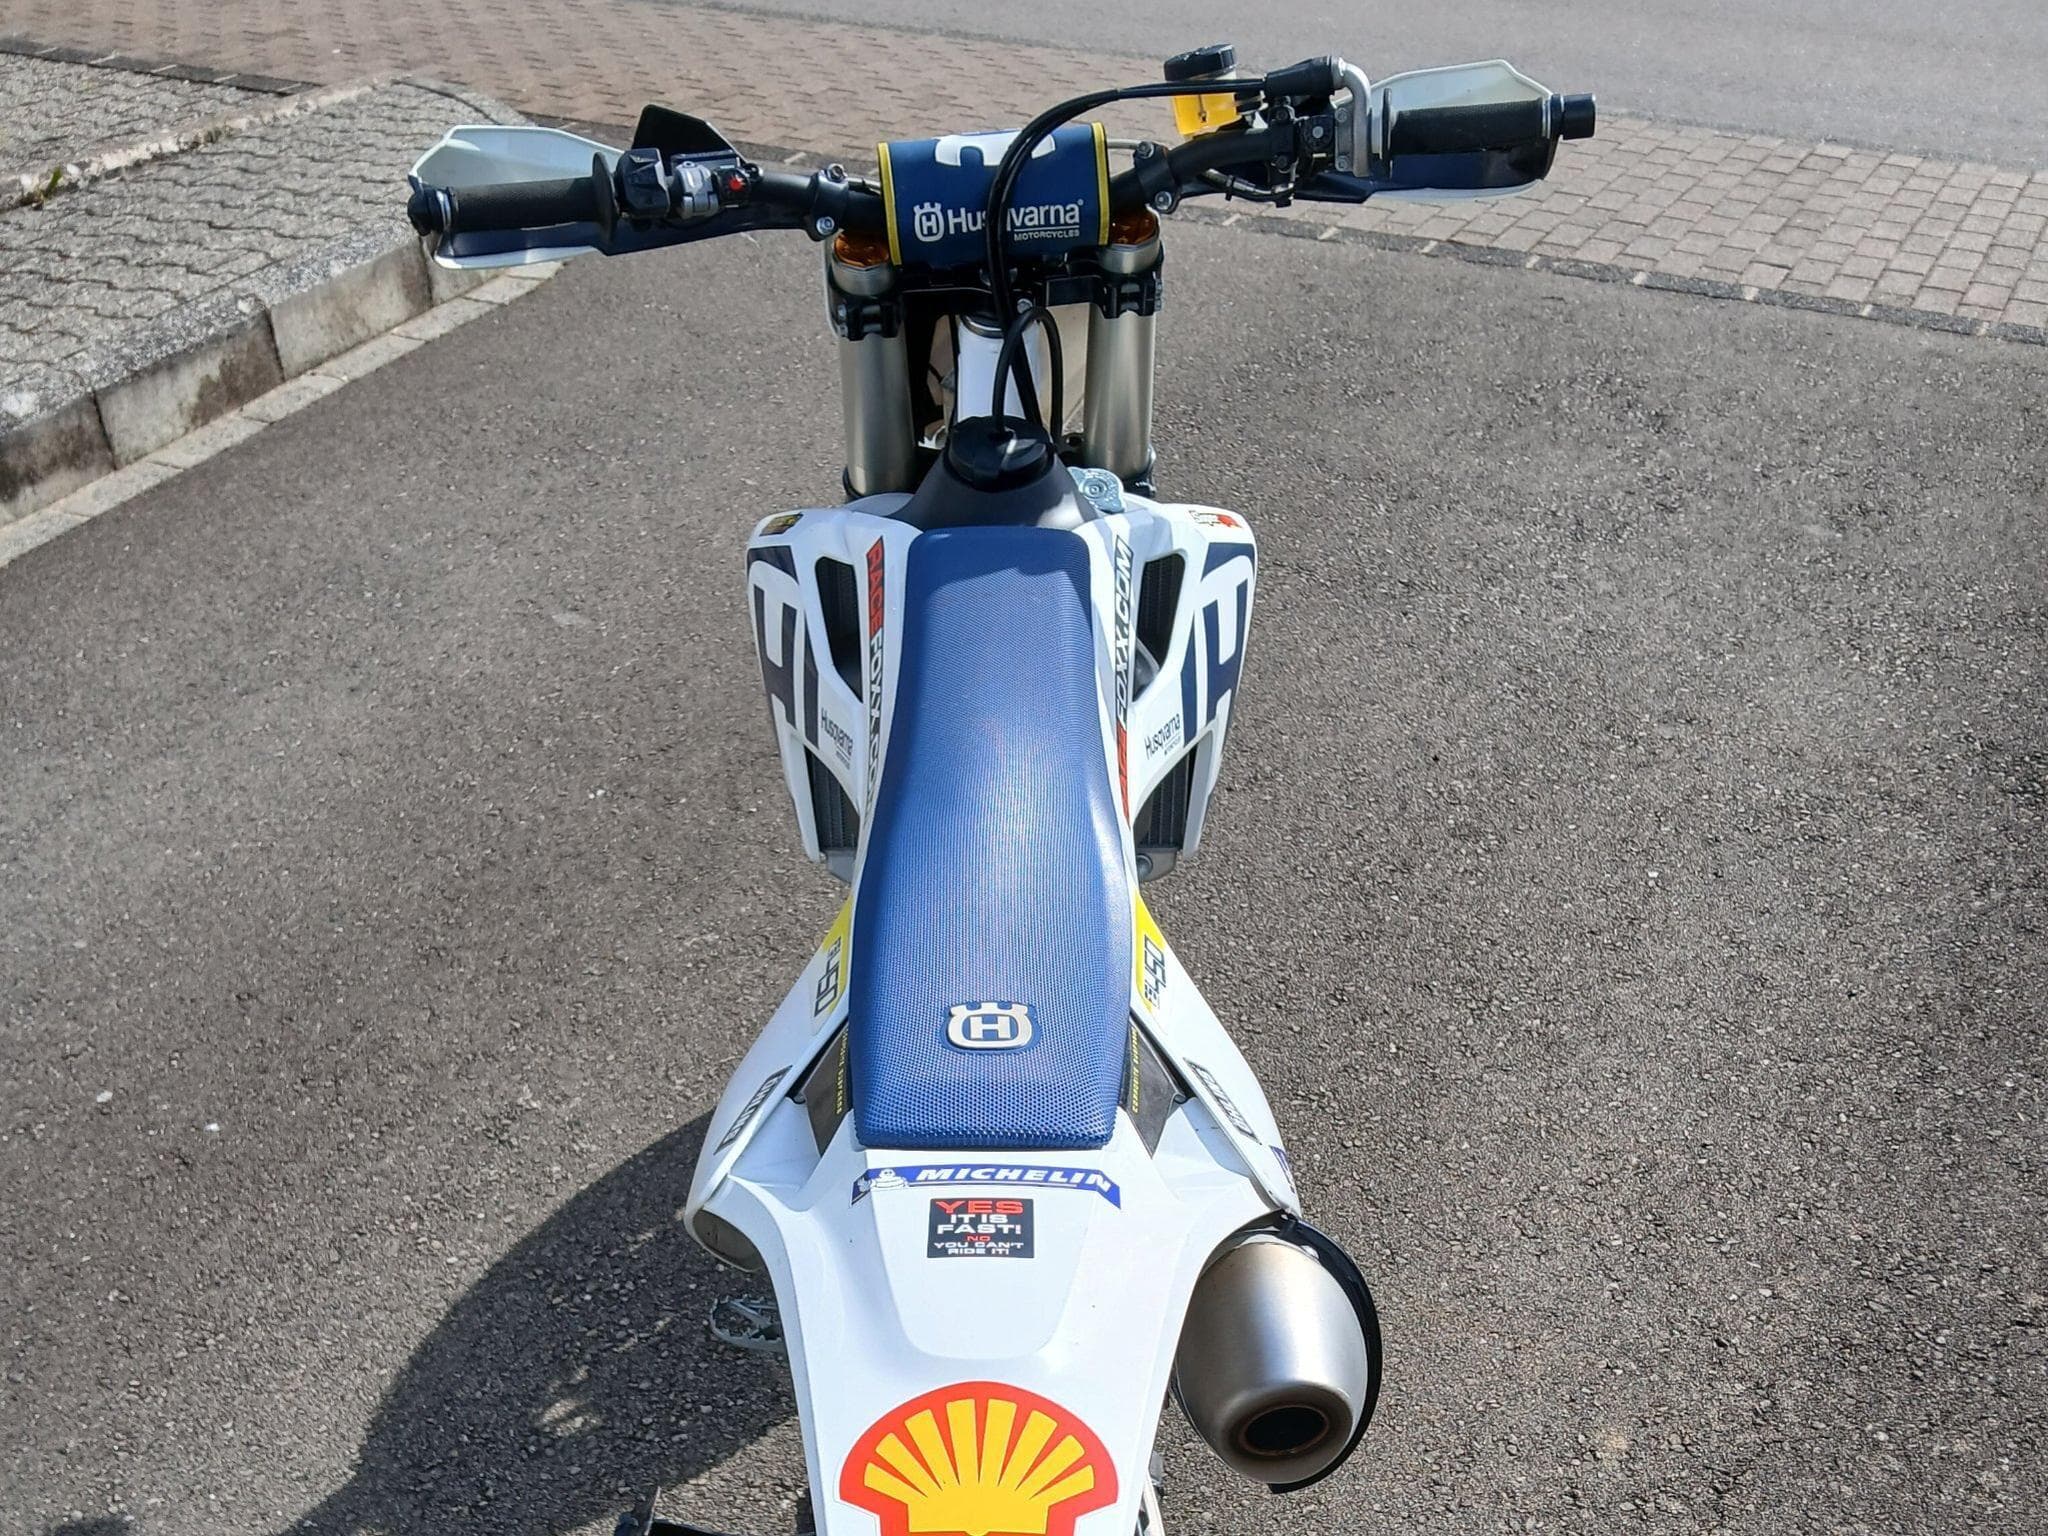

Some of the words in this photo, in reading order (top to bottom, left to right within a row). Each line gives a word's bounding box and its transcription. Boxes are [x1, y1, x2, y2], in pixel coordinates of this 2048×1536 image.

[947, 203, 1081, 235] Huvarna
[1013, 229, 1080, 241] MOTORCYCLES
[916, 1166, 1113, 1193] MICHELIN
[936, 1200, 1024, 1214] YES
[951, 1213, 976, 1224] IT
[981, 1213, 1009, 1224] IS
[937, 1223, 1022, 1235] FAST!
[934, 1241, 969, 1249] YOU
[974, 1241, 1025, 1249] CAN'T
[947, 1247, 986, 1255] RIDE
